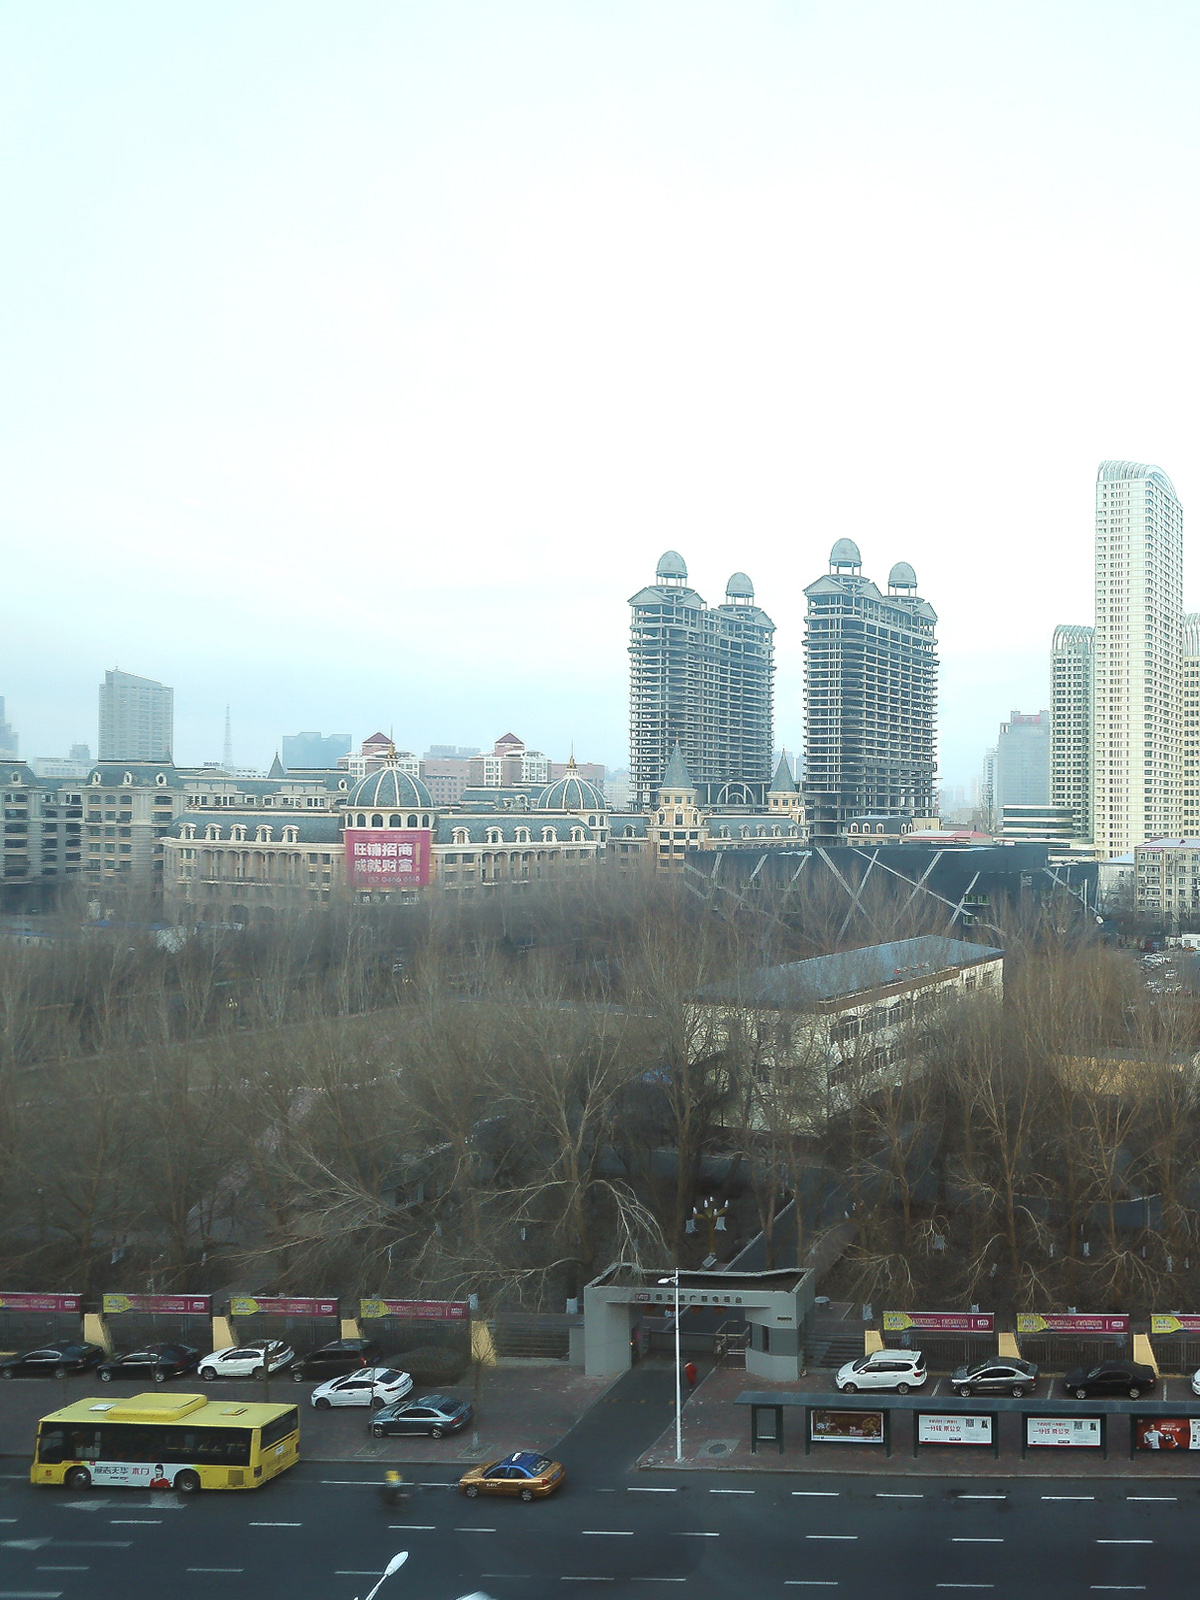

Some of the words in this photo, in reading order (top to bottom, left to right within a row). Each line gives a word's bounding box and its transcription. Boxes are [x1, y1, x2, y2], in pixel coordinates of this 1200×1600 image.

[354, 842, 413, 857] 旺铺招商
[354, 858, 413, 873] 成就财富
